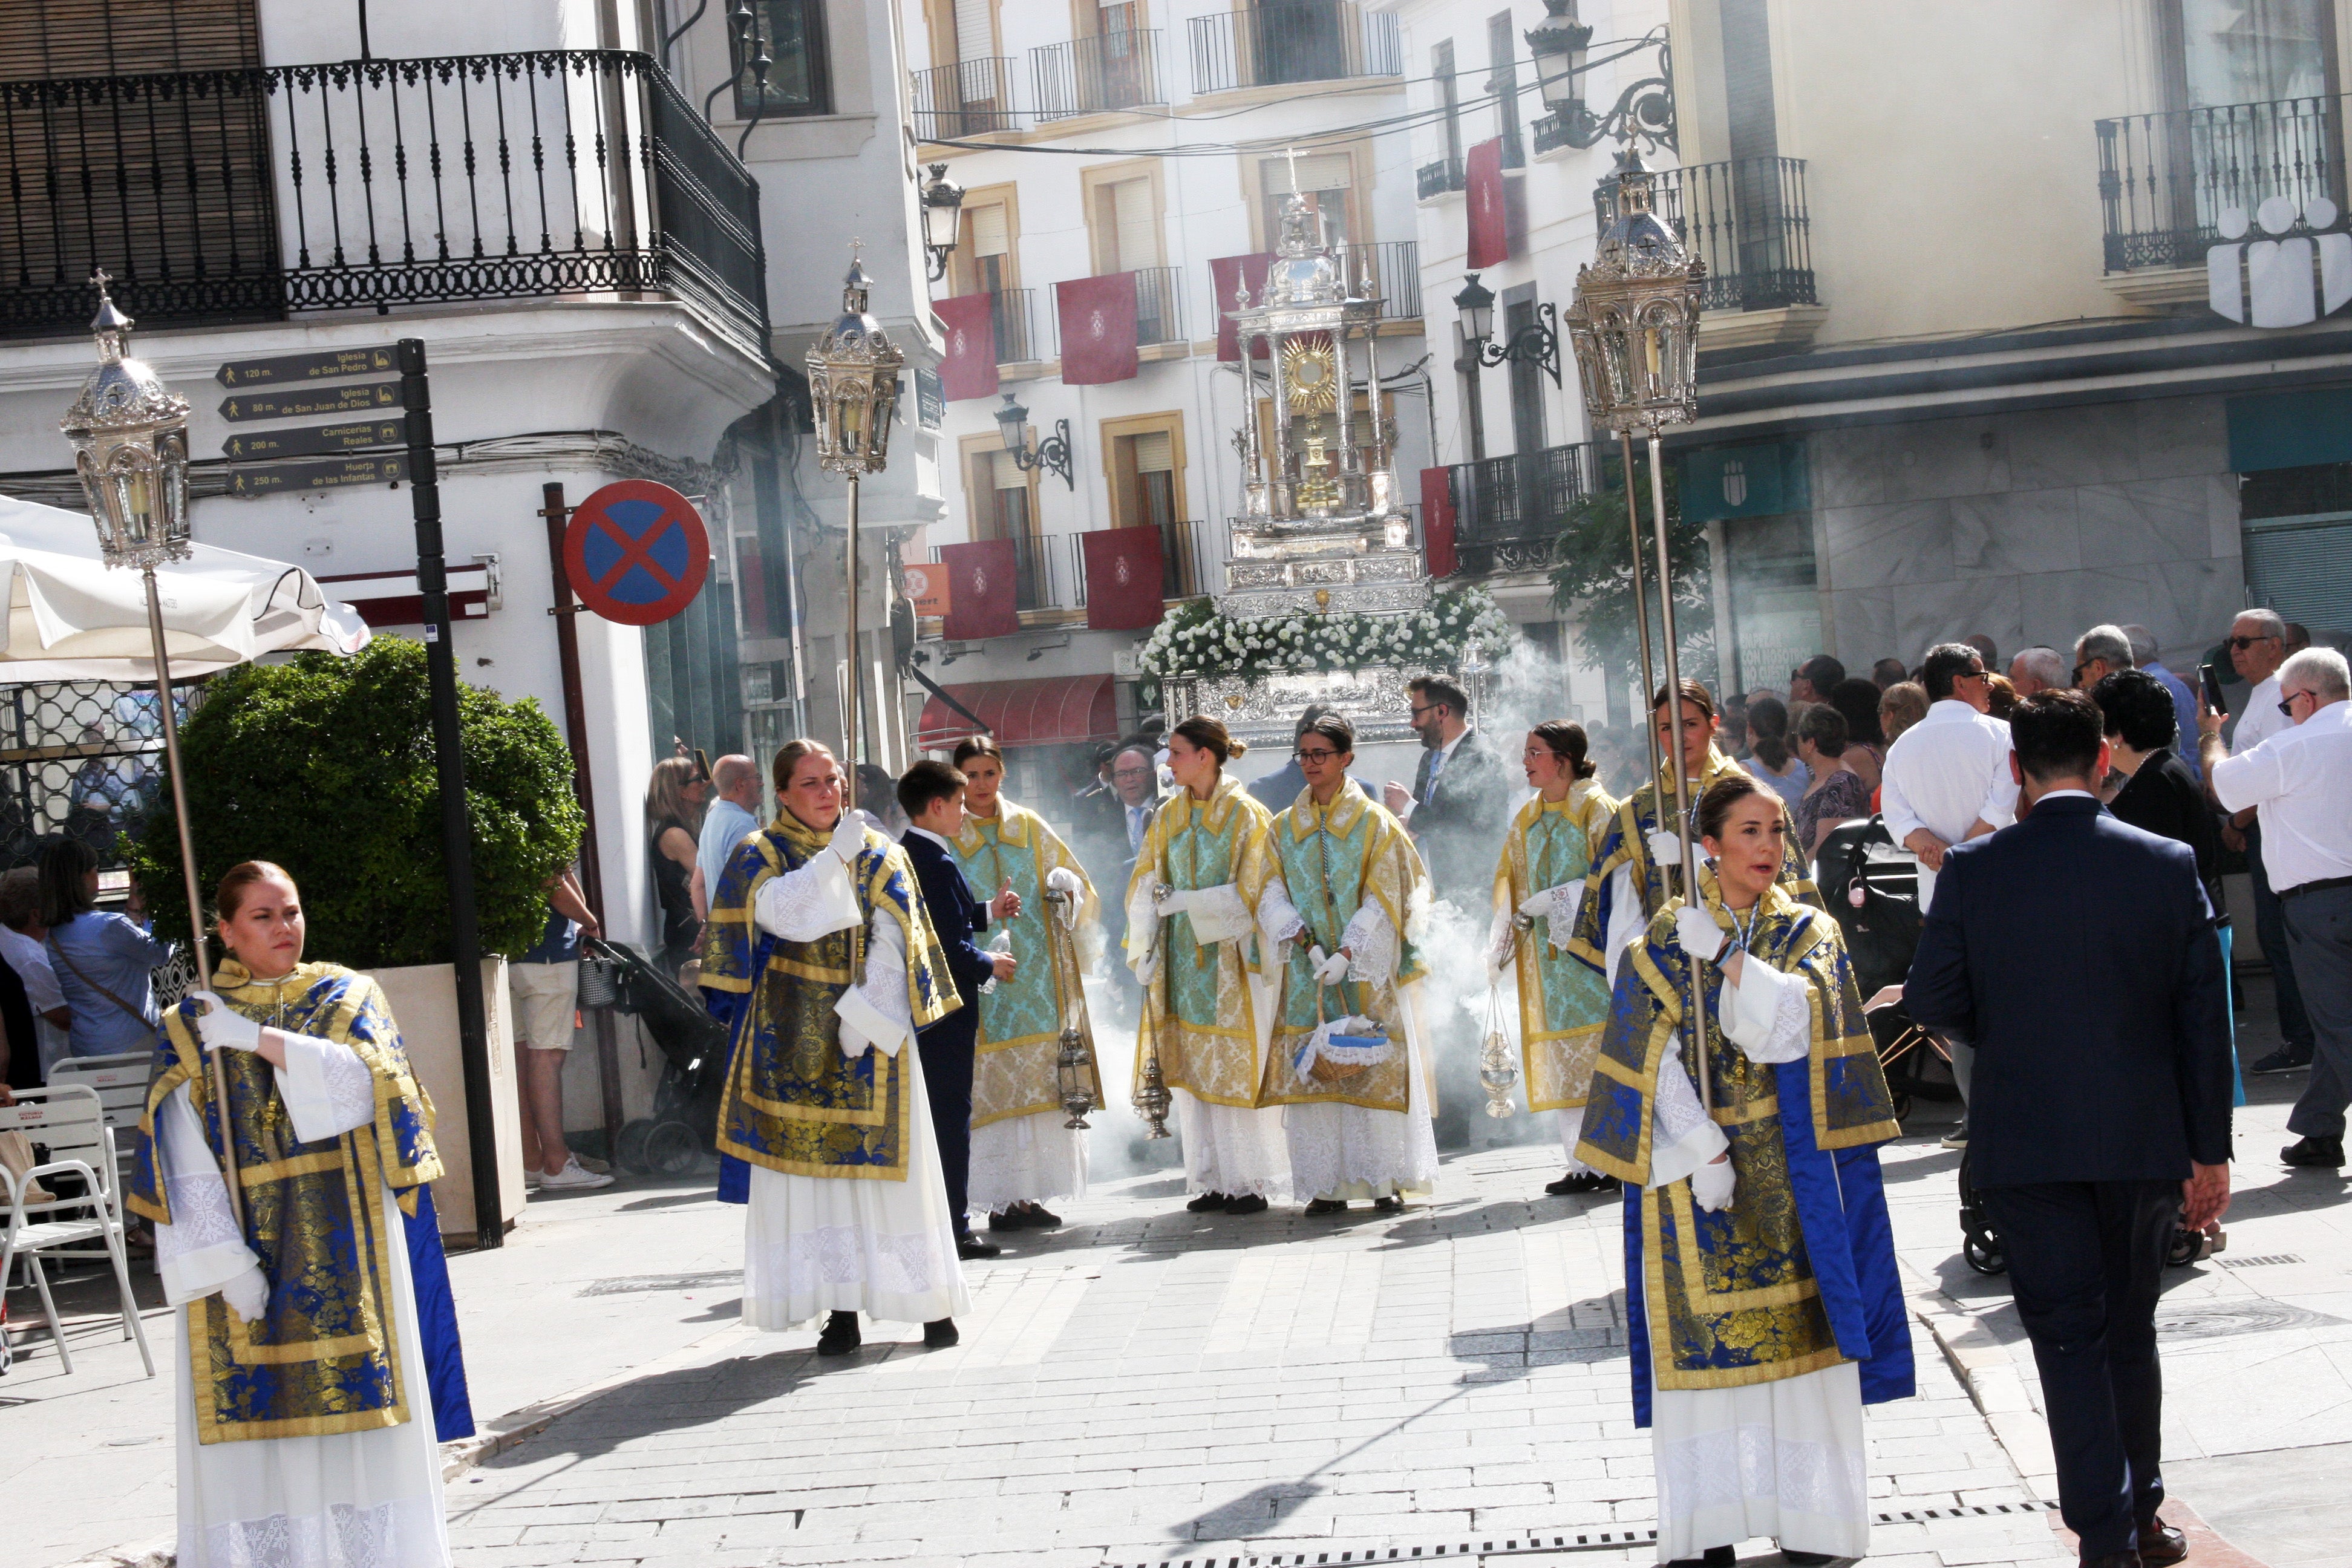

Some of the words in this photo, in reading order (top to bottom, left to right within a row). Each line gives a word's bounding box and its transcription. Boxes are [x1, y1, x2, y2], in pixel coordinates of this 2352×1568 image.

[337, 352, 366, 363] Iglesia
[244, 369, 260, 378] 120
[309, 367, 320, 376] de
[341, 363, 367, 373] Pedro
[341, 388, 370, 399] Iglesia
[252, 403, 263, 412] 80
[295, 404, 312, 413] San
[314, 403, 335, 411] Juan
[351, 399, 370, 408] Dios
[343, 436, 373, 445] Reales
[251, 441, 266, 450] 200
[345, 462, 374, 471] Huerta
[254, 477, 269, 485] 250
[341, 473, 375, 483] Infantas
